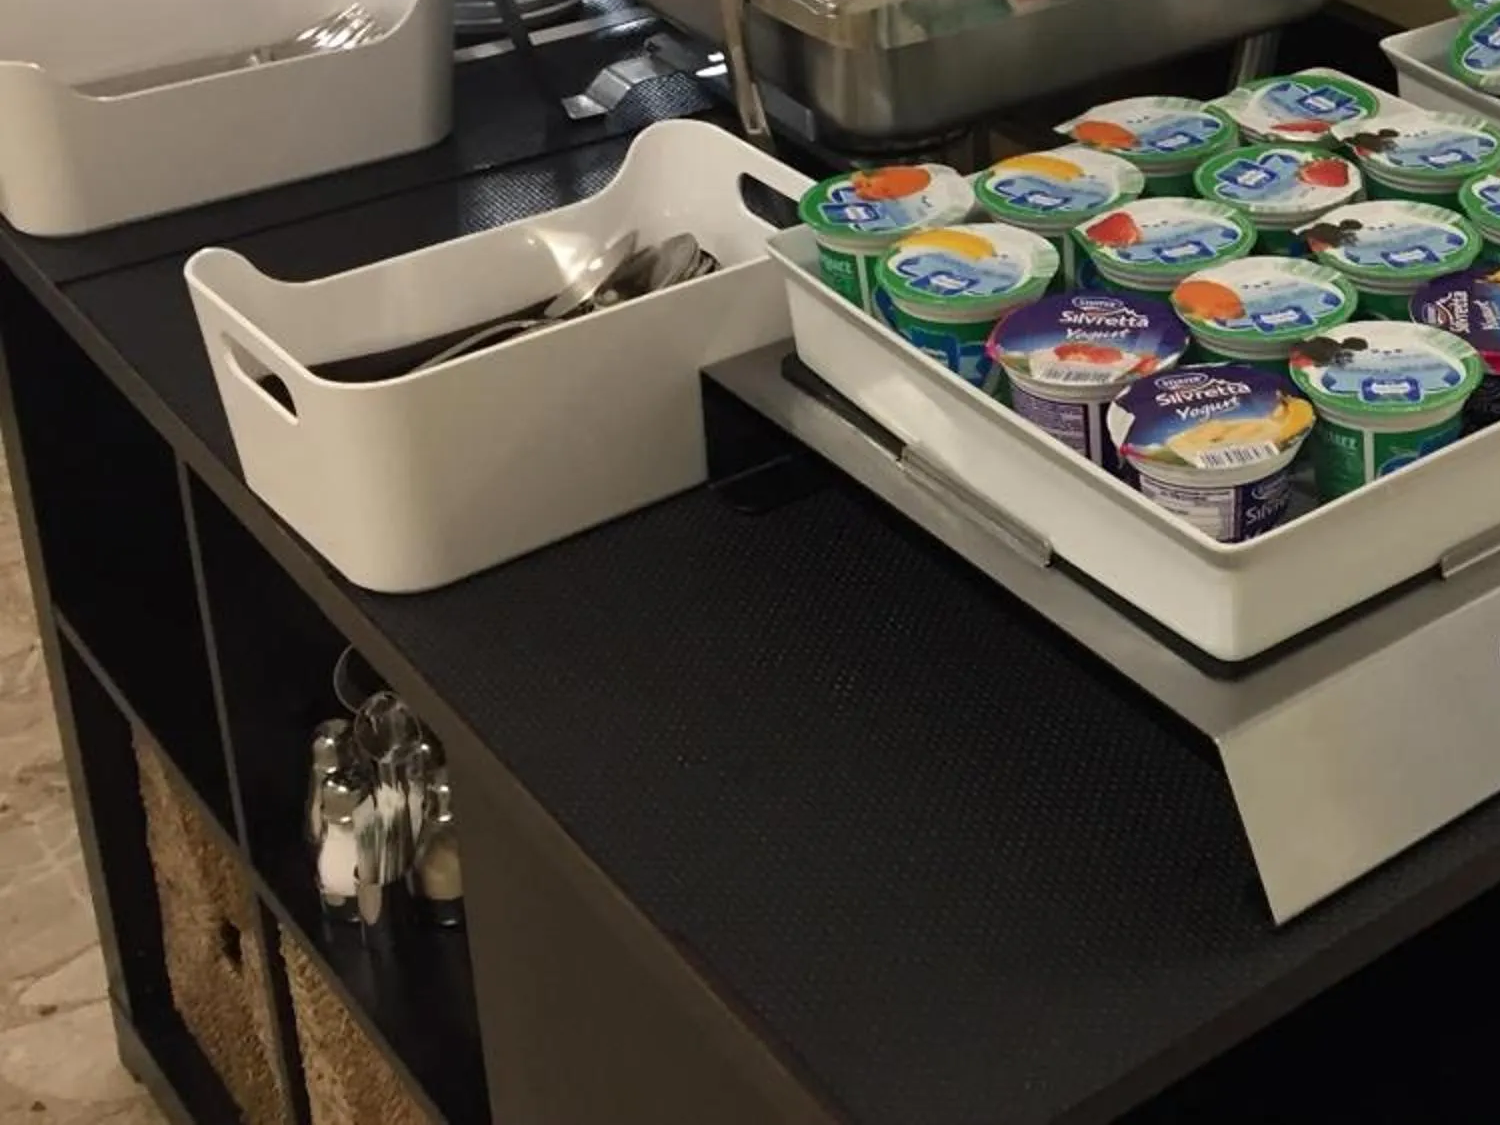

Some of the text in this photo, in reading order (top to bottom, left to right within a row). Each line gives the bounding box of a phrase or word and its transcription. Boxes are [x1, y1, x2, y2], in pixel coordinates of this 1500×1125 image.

[1059, 310, 1150, 328] Silvretta
[1155, 382, 1252, 407] Silvretta
[1175, 396, 1240, 422] Yogurt
